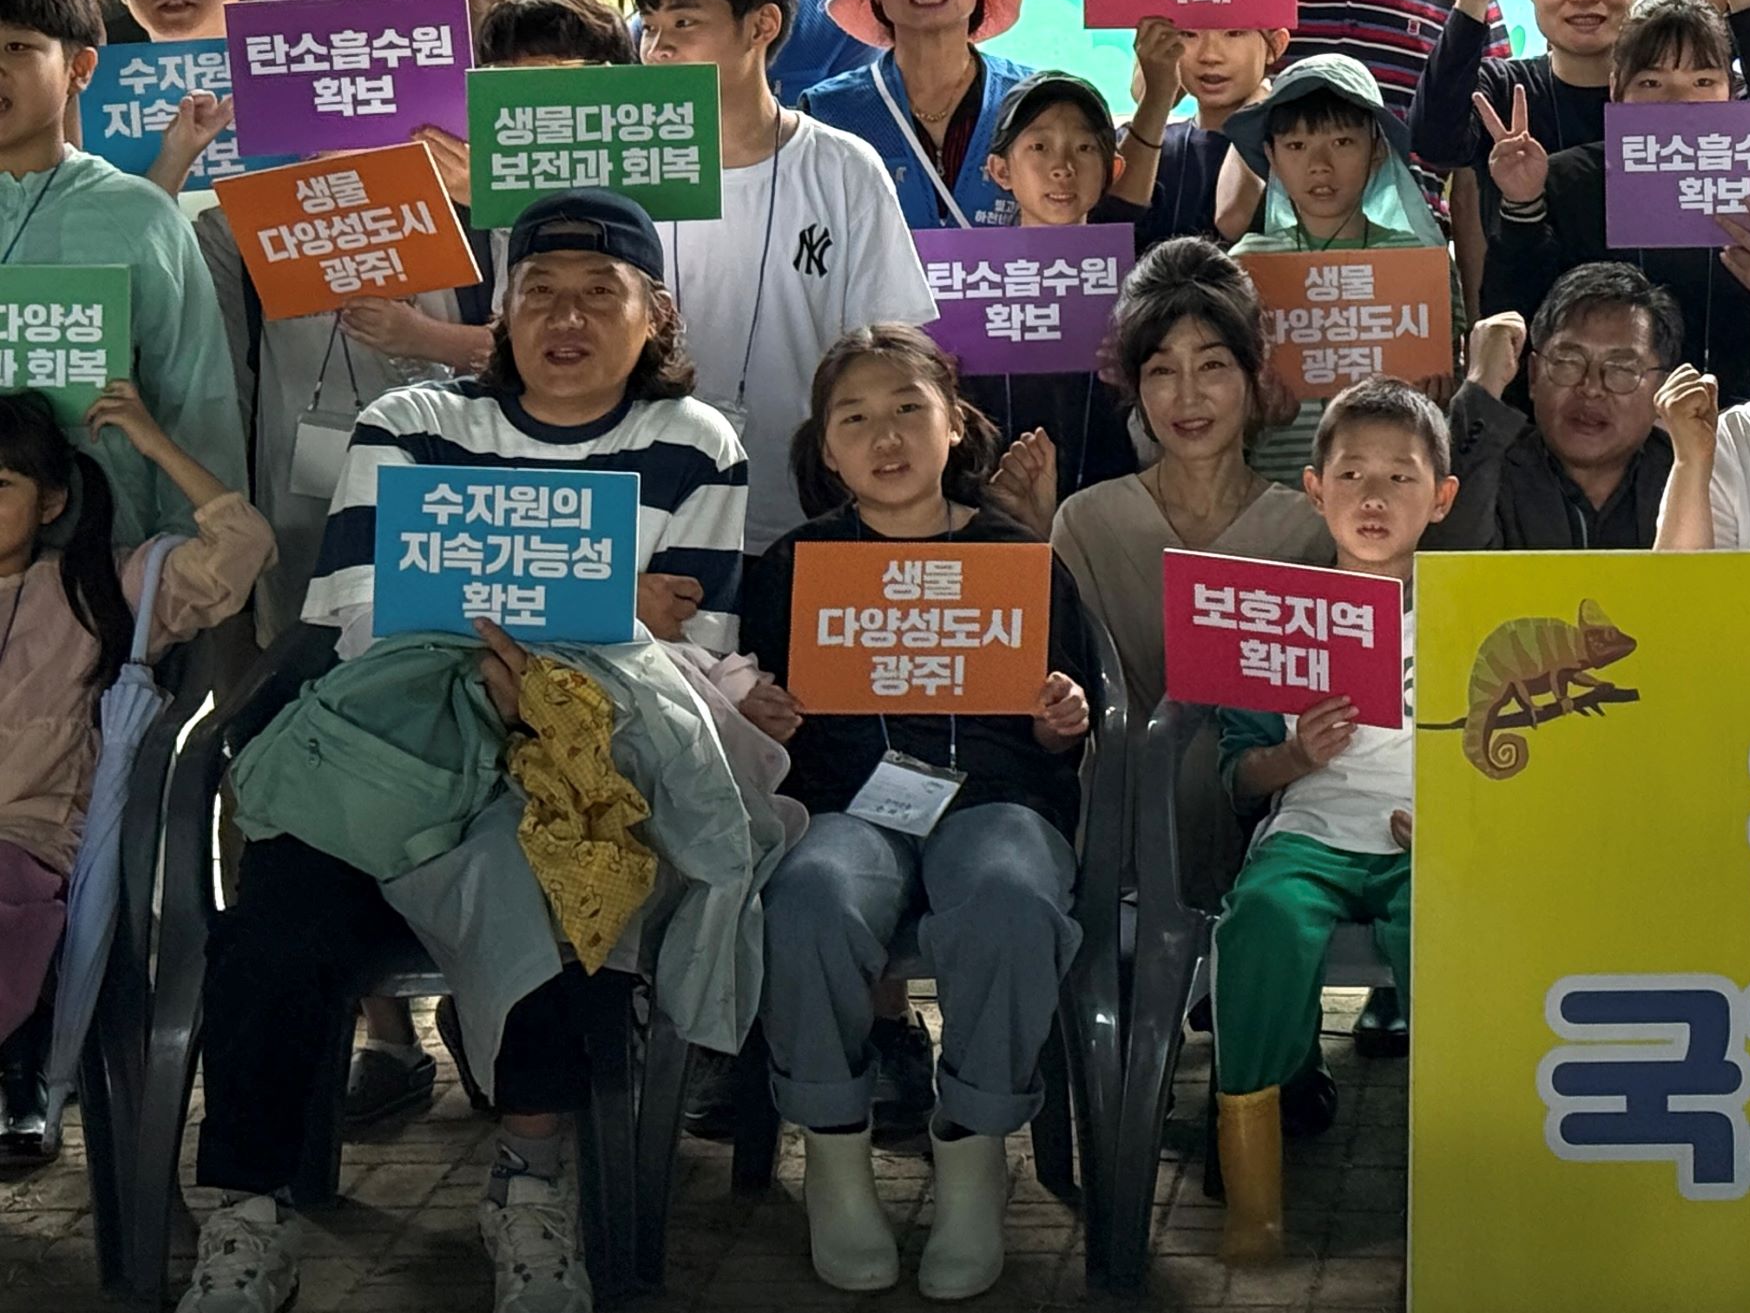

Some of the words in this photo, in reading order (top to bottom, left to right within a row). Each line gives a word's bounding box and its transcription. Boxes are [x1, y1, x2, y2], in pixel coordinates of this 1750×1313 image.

[246, 25, 454, 75] 탄소흡수원
[119, 51, 232, 95] 수자원
[313, 75, 397, 116] 확보
[495, 102, 694, 146] 생물다양성
[491, 149, 613, 190] 보전과
[622, 146, 700, 185] 회복
[297, 170, 369, 213] 생물
[1679, 177, 1750, 215] 확보
[258, 201, 437, 262] 다양성도시
[319, 248, 407, 293] 광주!
[927, 257, 1119, 299] 탄소흡수원
[1305, 264, 1375, 300] 생물
[0, 303, 103, 342] 다양성
[986, 303, 1061, 342] 확보
[27, 349, 107, 388] 회복
[422, 484, 592, 530] 수자원의
[400, 532, 612, 579] 지속가능성
[882, 560, 963, 600] 생물
[463, 582, 546, 626] 확보
[1193, 584, 1374, 648] 보호지역
[817, 607, 1022, 648] 다양성도시
[871, 655, 964, 696] 광주!
[1240, 639, 1329, 692] 확대
